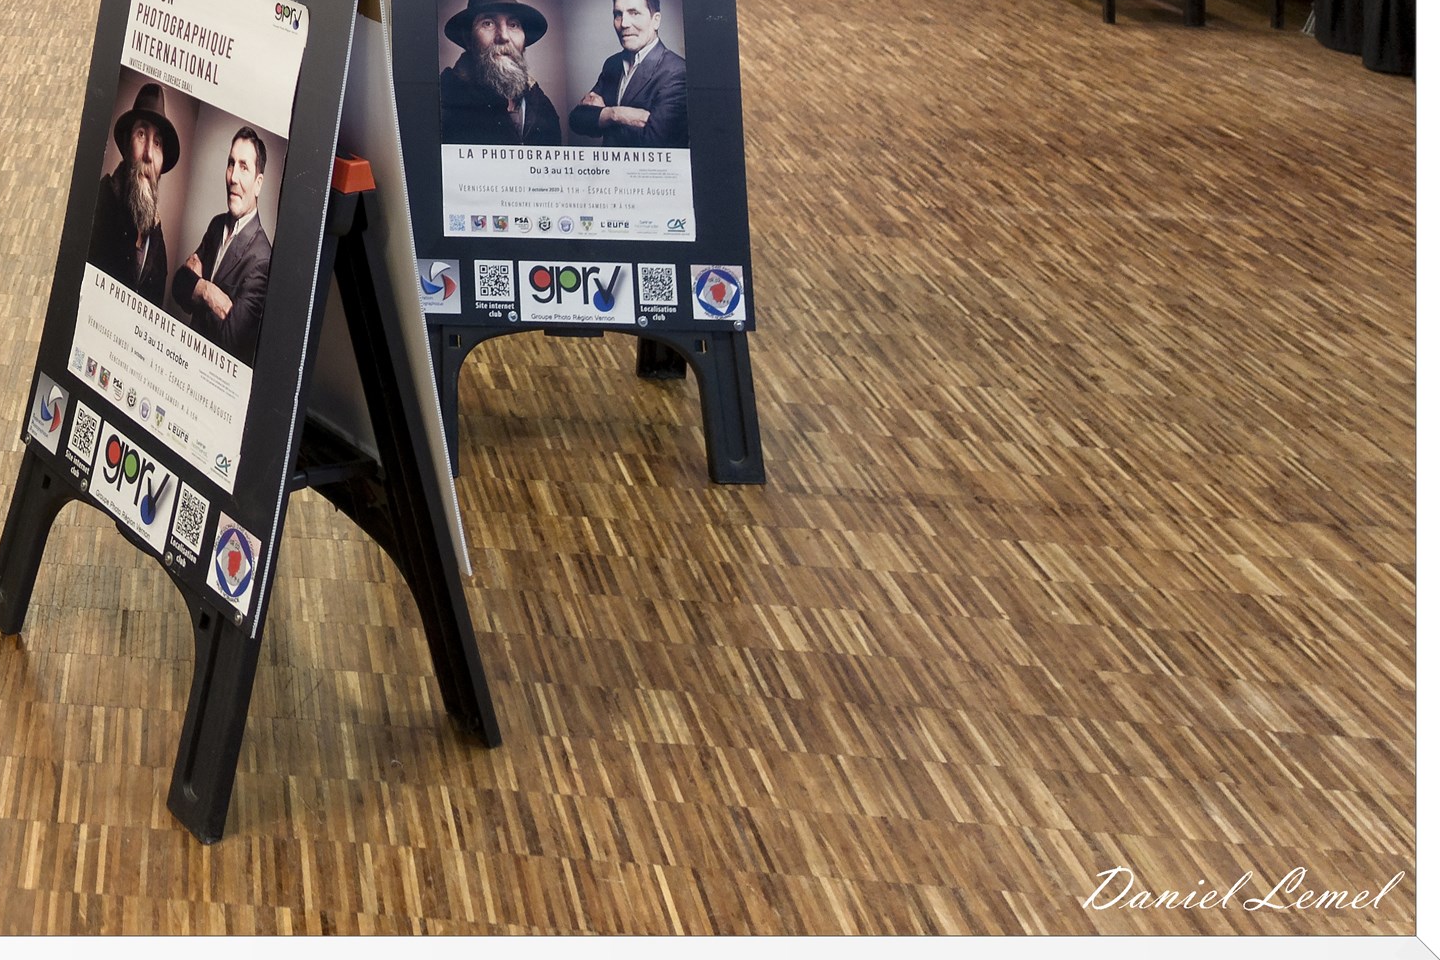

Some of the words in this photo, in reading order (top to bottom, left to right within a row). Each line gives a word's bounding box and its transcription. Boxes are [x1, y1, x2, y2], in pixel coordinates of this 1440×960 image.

[136, 3, 235, 60] PHOTOGRAPHIQUE
[131, 29, 219, 86] INTERNATIONAL
[459, 148, 474, 159] LA
[482, 148, 585, 161] PHOTOGRAPHIE
[593, 151, 672, 162] HUMANISTE
[530, 166, 542, 174] Du
[544, 166, 549, 174] 3
[577, 167, 610, 176] octobre
[489, 302, 515, 310] internet
[640, 305, 677, 313] Localisation
[531, 313, 553, 322] Groupe
[553, 313, 572, 321] Photo
[573, 313, 592, 322] Région
[652, 313, 666, 321] club
[95, 273, 105, 291] LA
[109, 282, 176, 337] PHOTOGRAPHIE
[180, 329, 239, 379] HUMANISTE
[134, 325, 143, 338] Du
[143, 330, 148, 341] 3
[148, 336, 157, 348] au
[156, 340, 164, 353] 11
[165, 346, 189, 370] octobre
[112, 377, 123, 390] PSA
[65, 449, 73, 462] Site
[72, 455, 90, 476] internet
[70, 466, 80, 478] club
[96, 489, 110, 506] Groupe
[110, 501, 121, 516] Photo
[170, 535, 197, 564] Localisation
[175, 554, 186, 568] club
